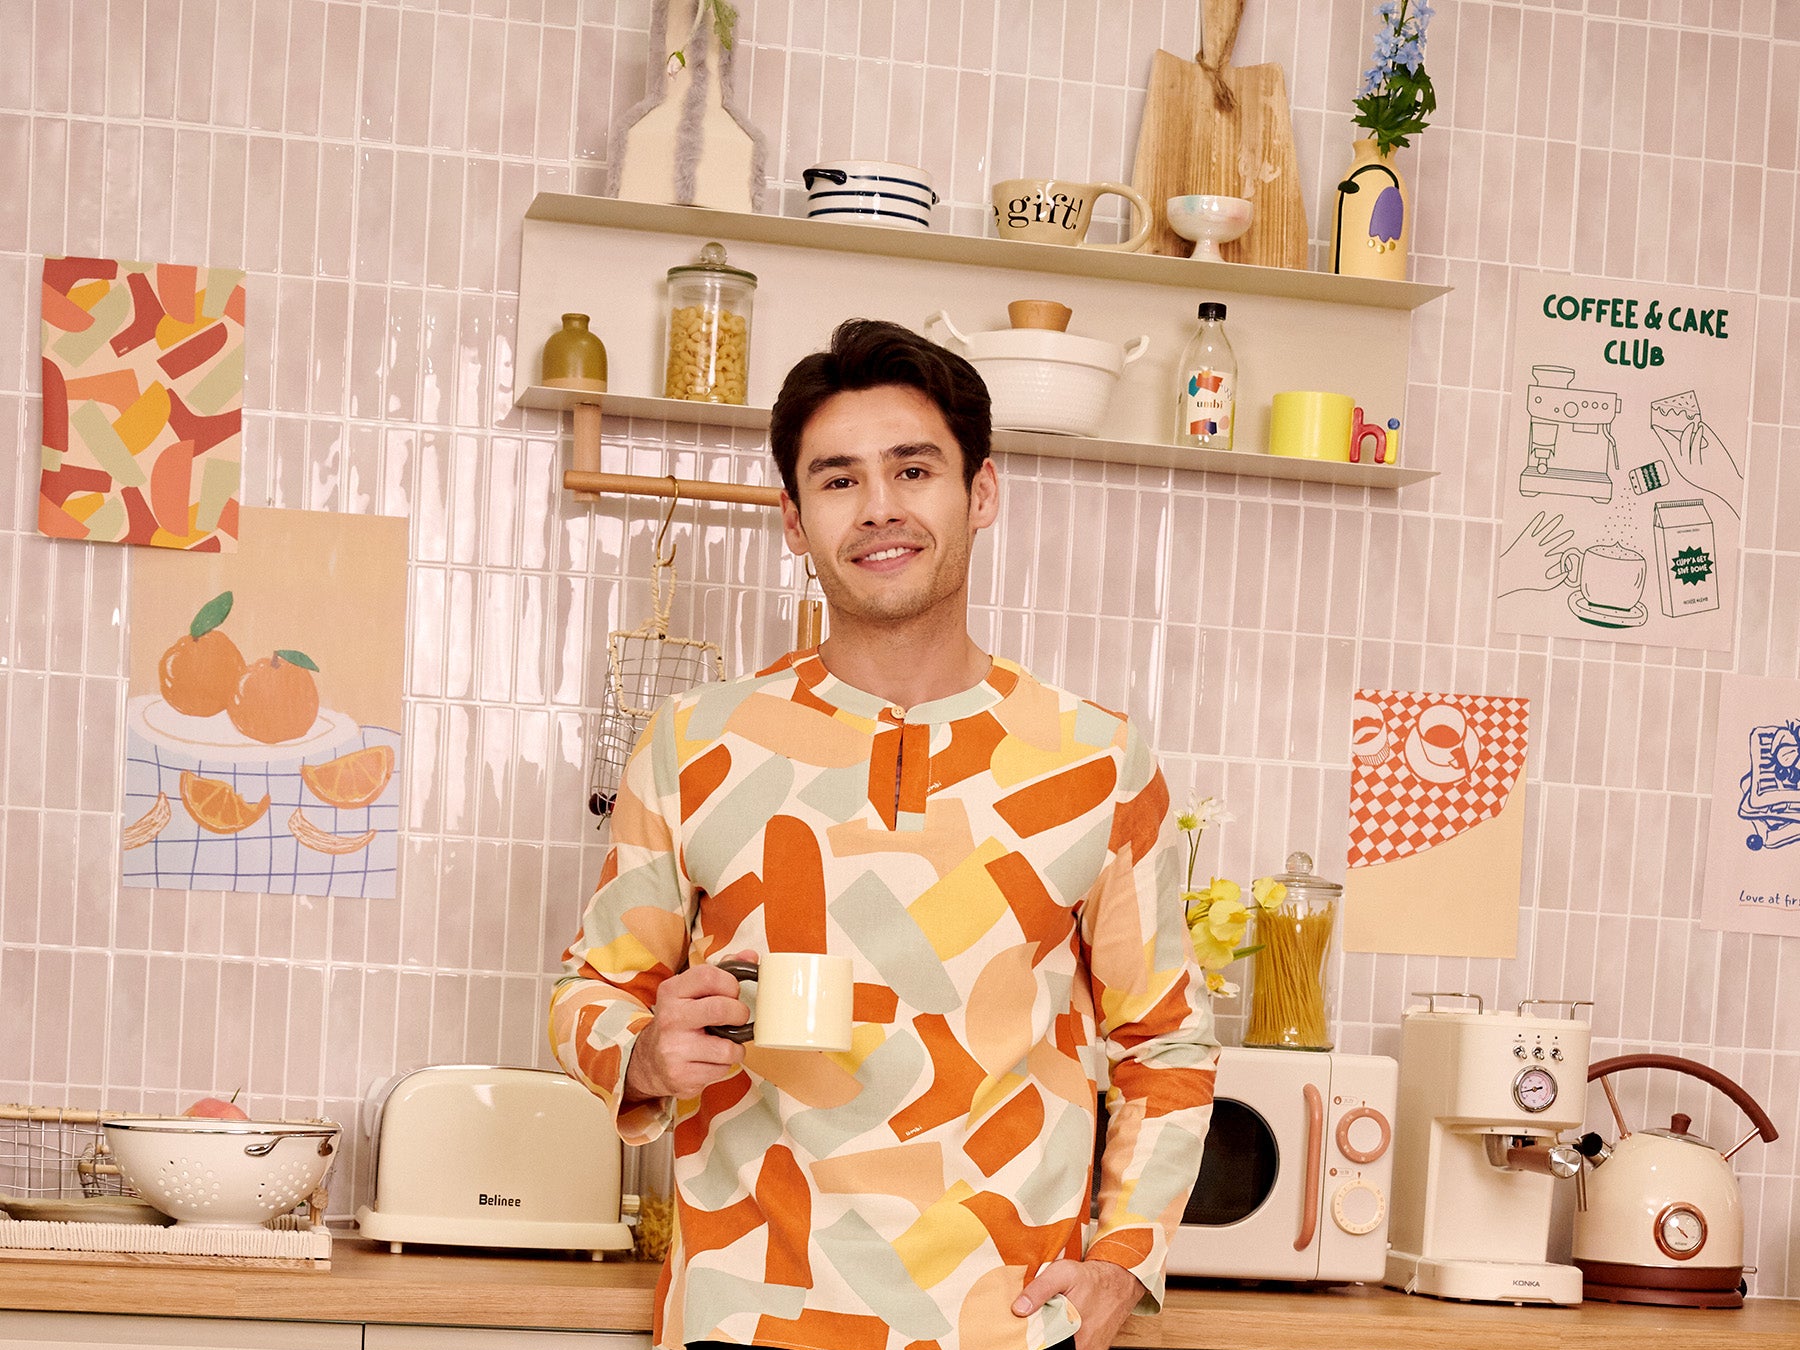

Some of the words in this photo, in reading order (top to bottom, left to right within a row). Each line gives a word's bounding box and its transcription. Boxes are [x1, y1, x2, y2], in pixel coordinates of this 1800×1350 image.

[1007, 193, 1083, 230] gift!
[1543, 294, 1639, 330] COFFEE
[1644, 300, 1663, 330] &
[1668, 307, 1729, 339] CAKE
[1604, 338, 1665, 370] CLUB
[1349, 406, 1401, 465] hi
[1739, 890, 1764, 903] Love
[1768, 893, 1780, 905] at
[478, 1193, 521, 1207] Belinee
[1512, 1280, 1541, 1288] KONKA
